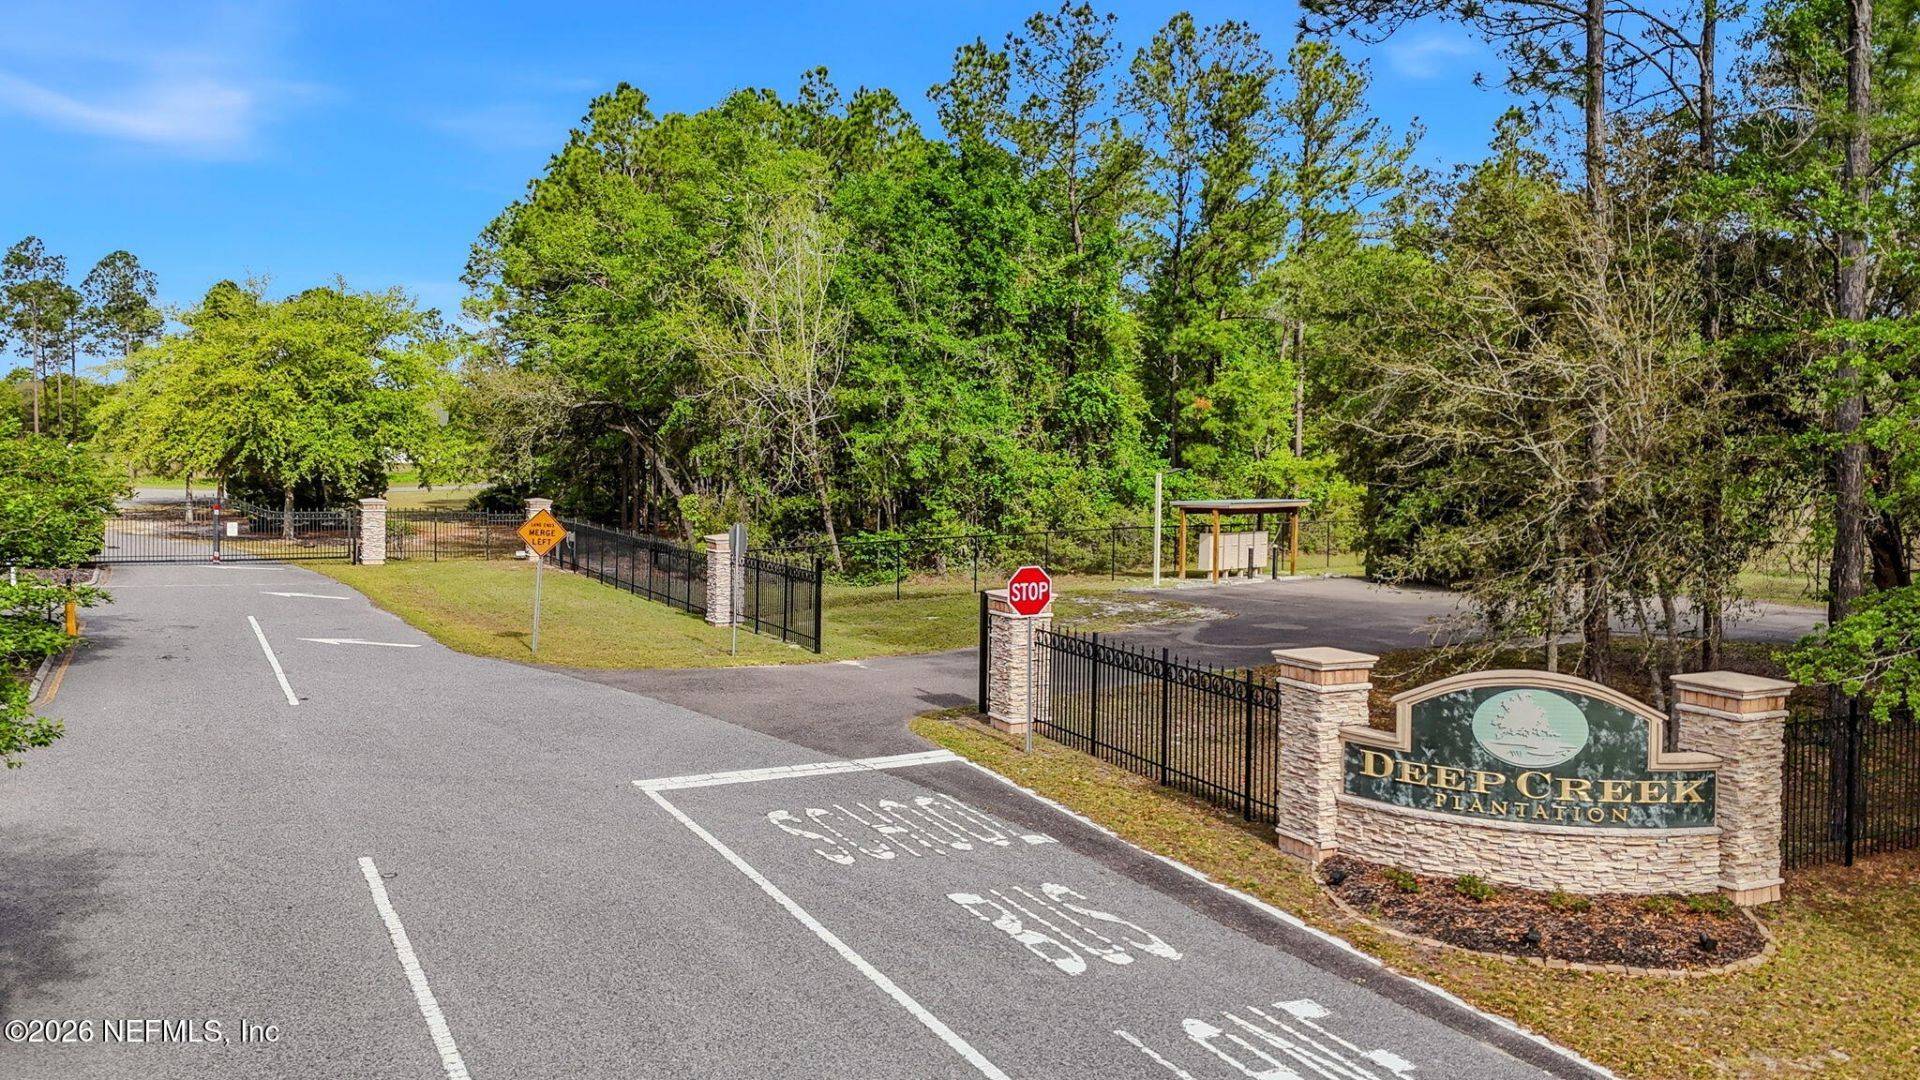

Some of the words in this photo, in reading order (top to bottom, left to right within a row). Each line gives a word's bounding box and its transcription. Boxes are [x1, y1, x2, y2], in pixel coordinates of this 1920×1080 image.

[1011, 582, 1048, 601] STOP
[1359, 749, 1506, 795] DEEP
[1516, 771, 1706, 804] CREEK
[767, 793, 1060, 865] SCHOOL
[1434, 793, 1630, 824] PLANTATION
[946, 882, 1184, 977] BUS
